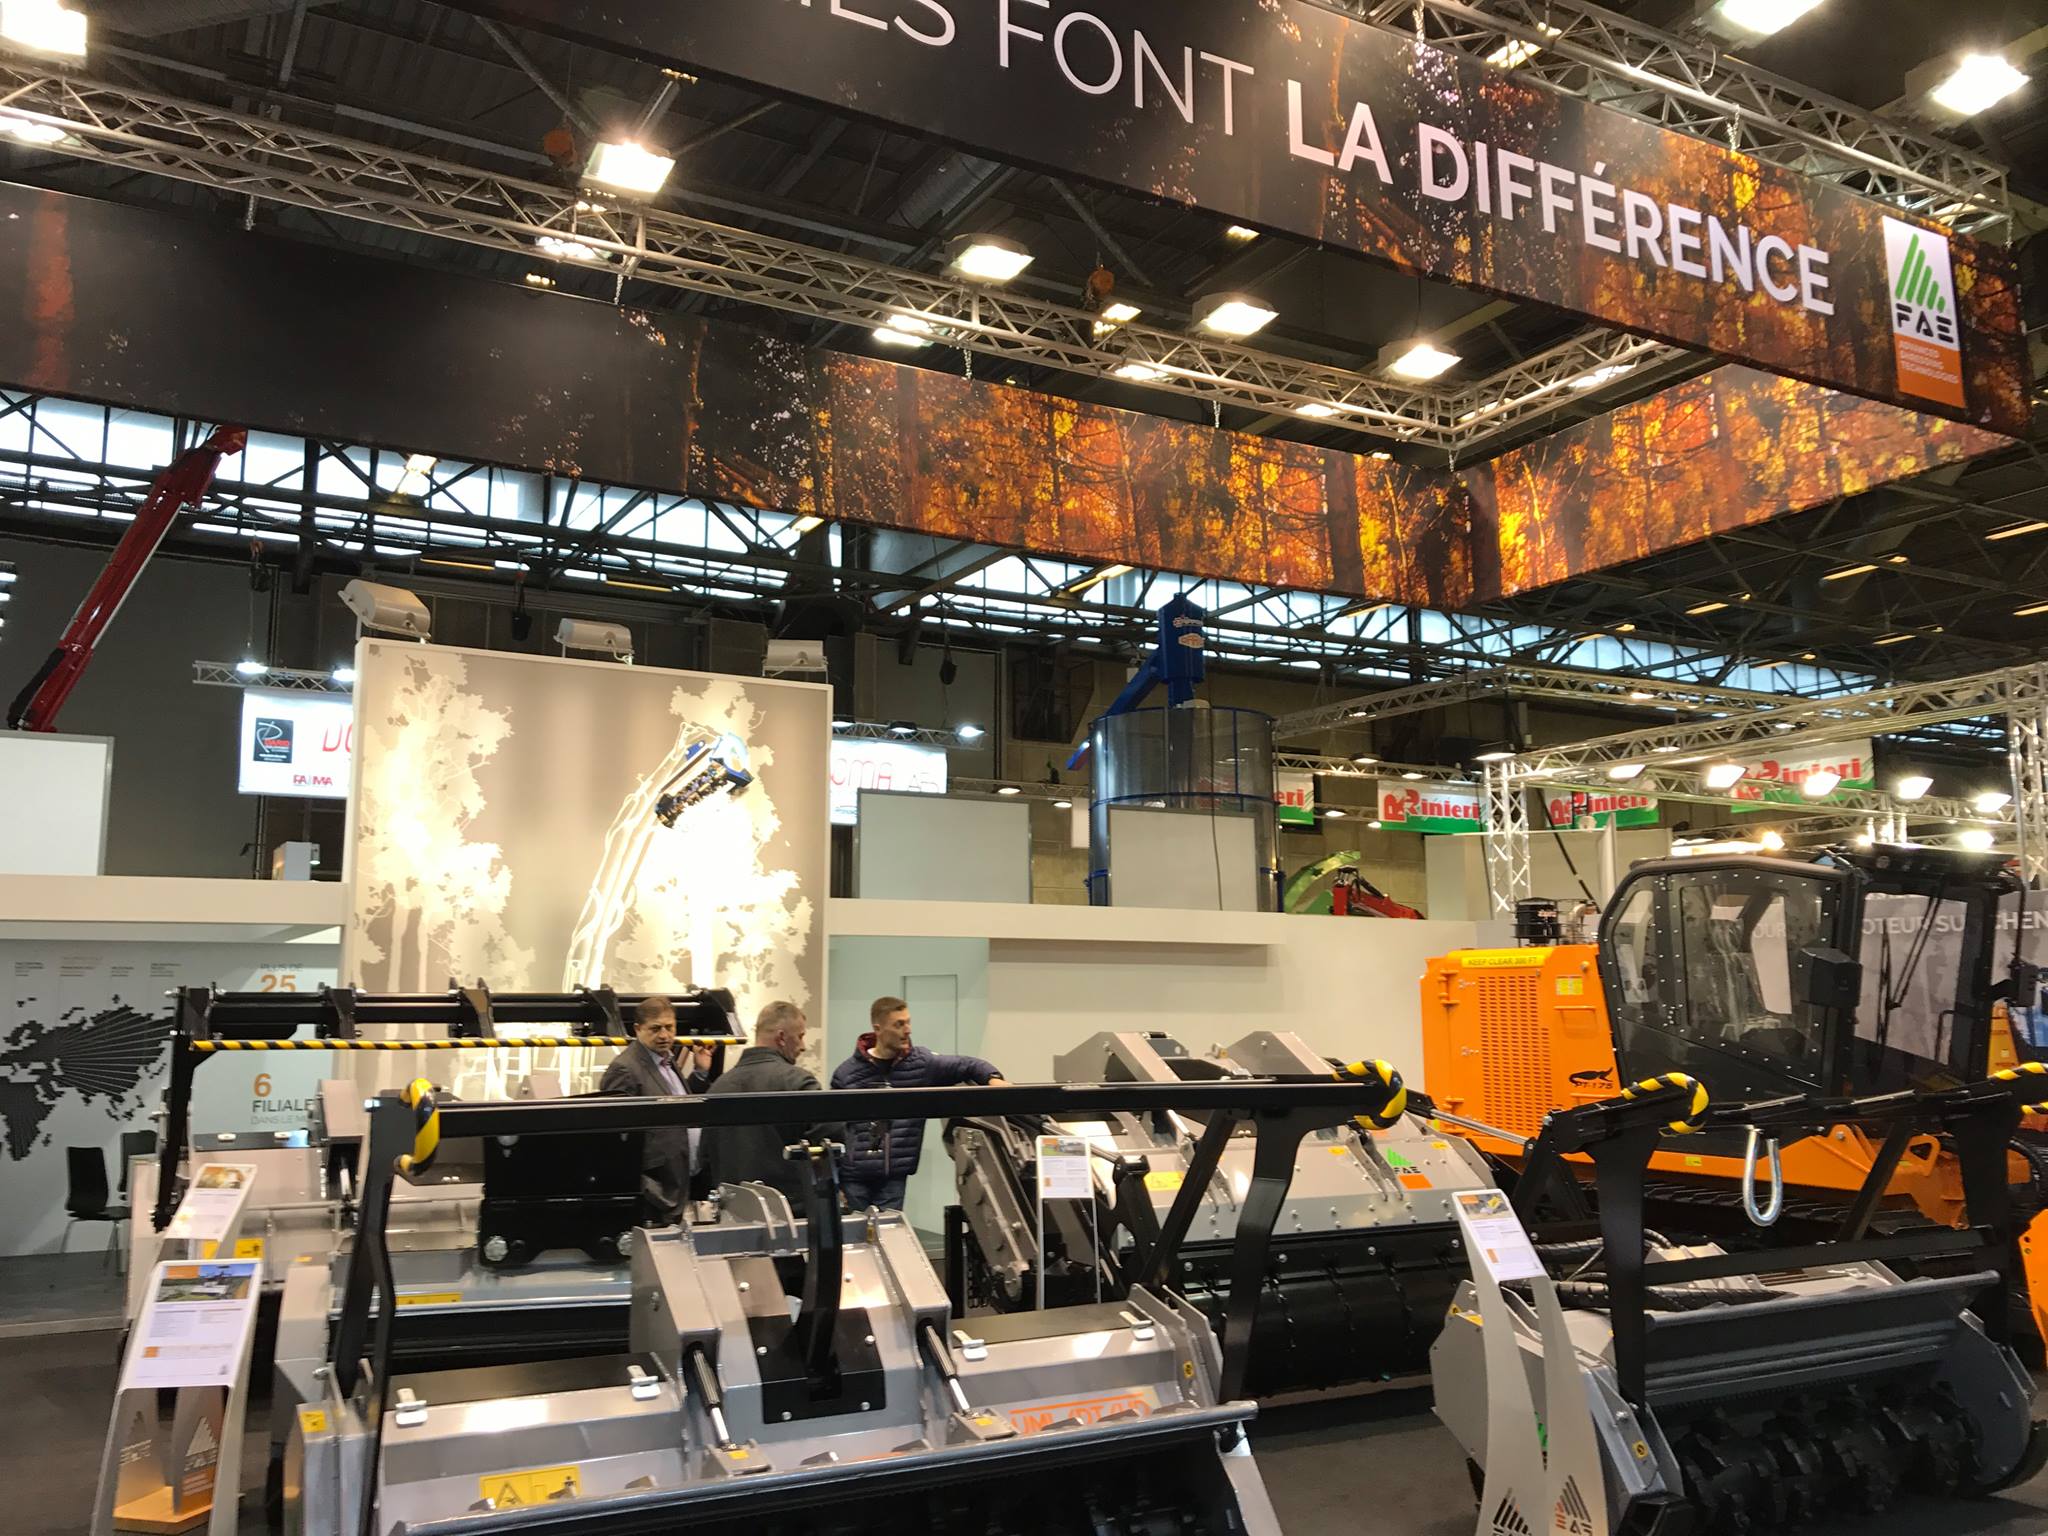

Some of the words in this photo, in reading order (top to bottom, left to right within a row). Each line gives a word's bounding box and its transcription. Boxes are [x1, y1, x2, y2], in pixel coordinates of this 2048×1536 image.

[999, 0, 1255, 136] FONT
[1287, 79, 1394, 184] LA
[1417, 122, 1836, 317] DIFFÉRENCE
[1895, 302, 1954, 344] FAE
[1752, 921, 1788, 938] OUR
[1935, 914, 1967, 933] SU
[253, 1072, 272, 1098] 6
